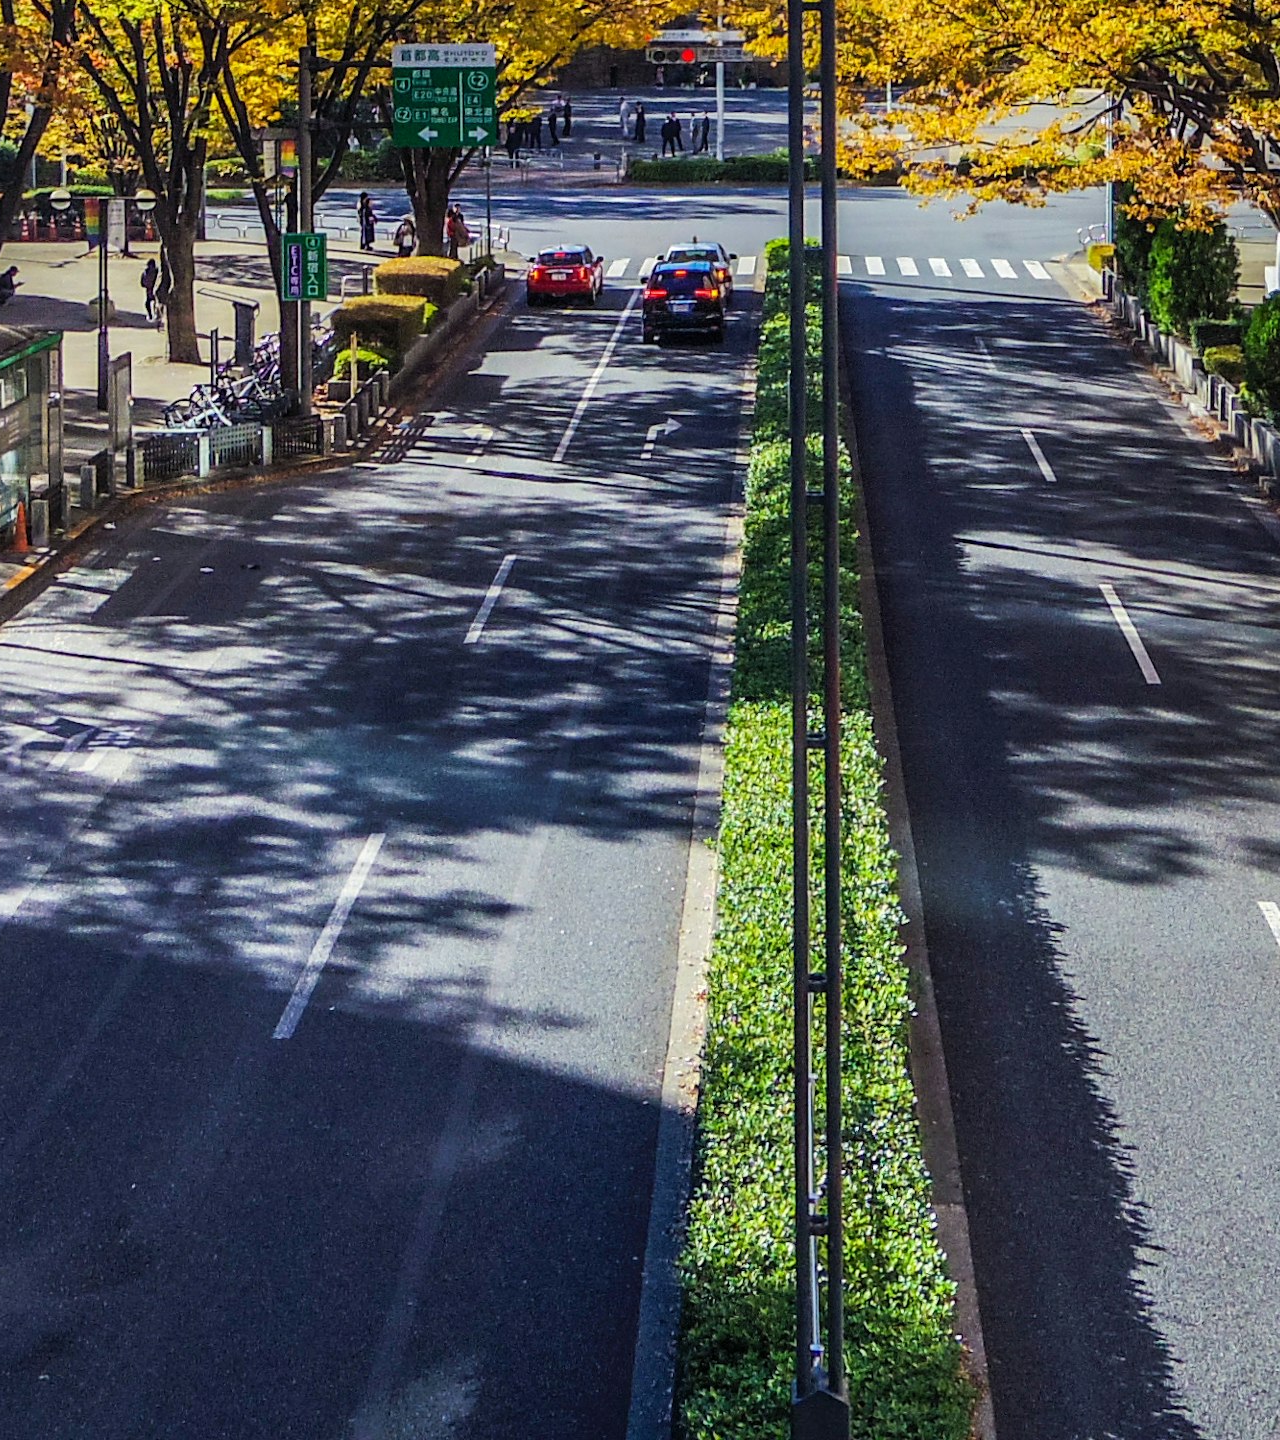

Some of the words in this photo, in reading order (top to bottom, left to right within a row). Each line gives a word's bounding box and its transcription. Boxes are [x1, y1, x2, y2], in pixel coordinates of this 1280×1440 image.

[401, 49, 440, 62] 首都高
[414, 91, 432, 99] E20
[434, 87, 458, 96] 中央道
[467, 96, 479, 104] E4
[415, 111, 427, 119] E1
[430, 107, 449, 116] 東名
[464, 107, 493, 116] 東北道
[290, 245, 299, 296] ETC専用
[307, 250, 319, 296] 新宿入口
